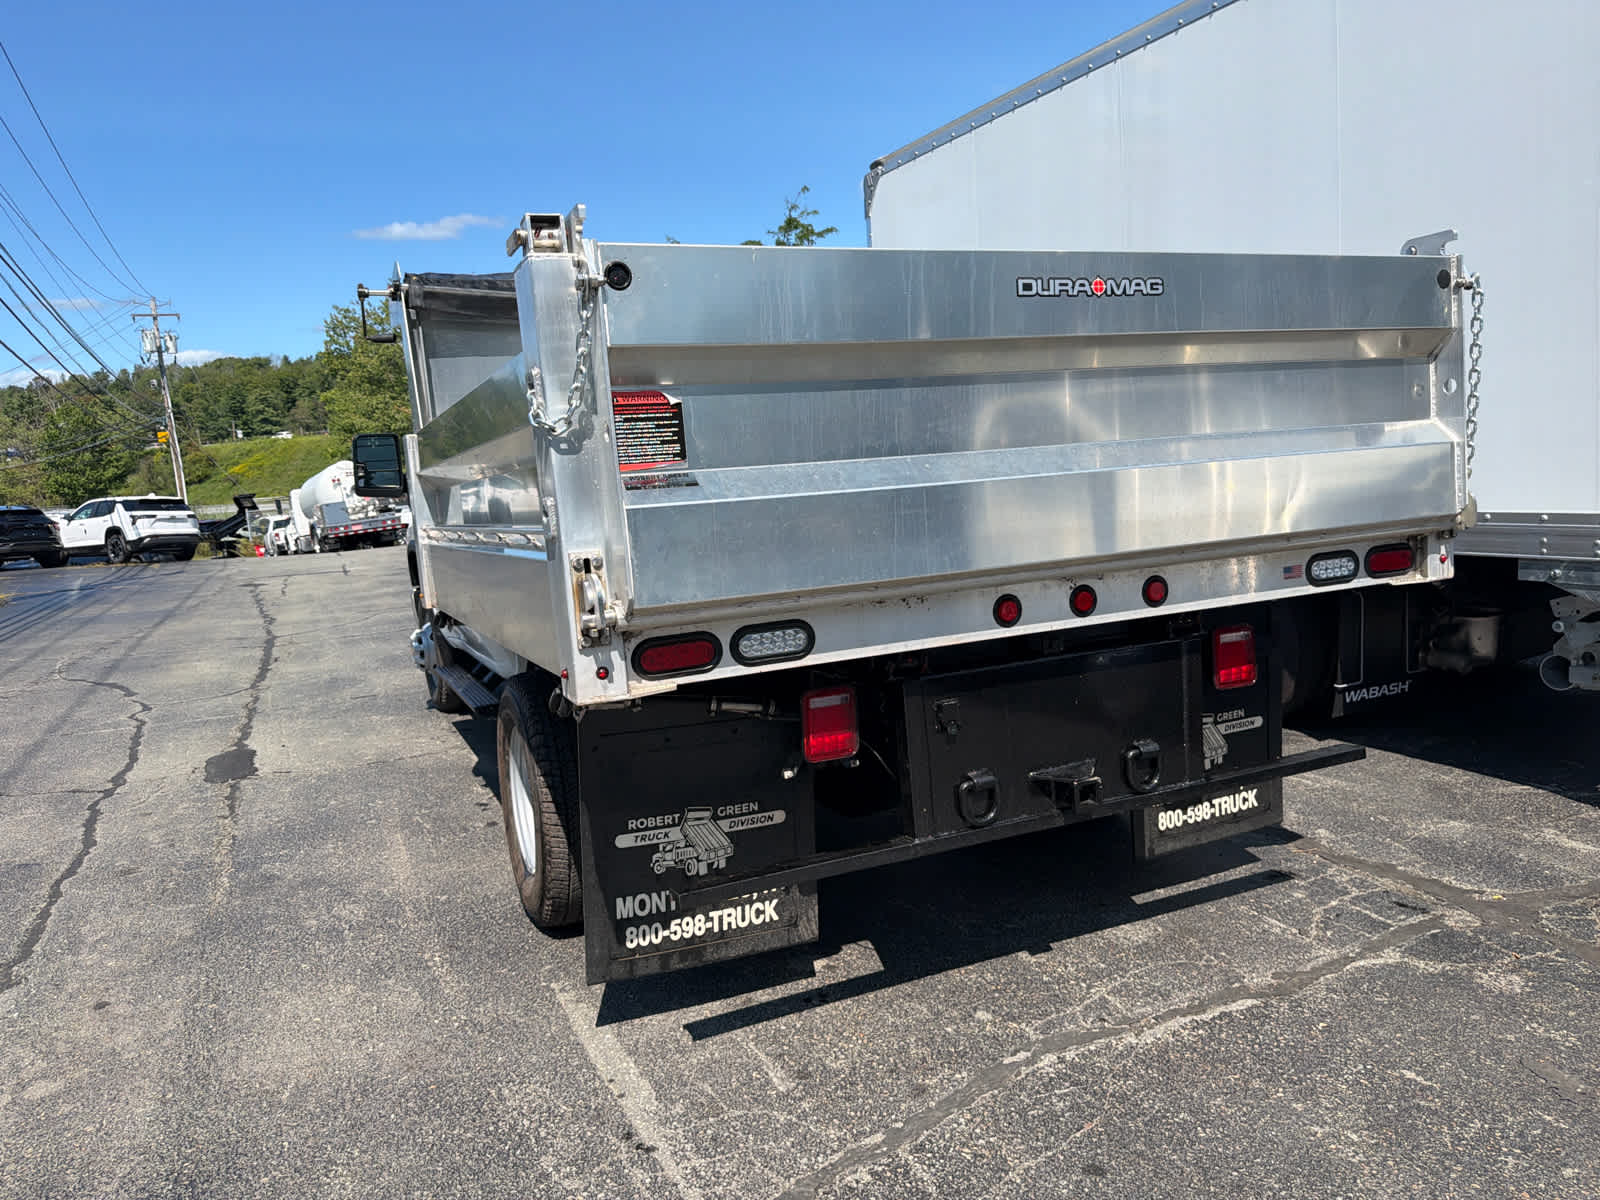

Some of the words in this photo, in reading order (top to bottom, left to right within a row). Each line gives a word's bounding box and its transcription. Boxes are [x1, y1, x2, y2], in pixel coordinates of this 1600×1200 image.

[1345, 681, 1409, 703] WABASH
[1217, 708, 1245, 722] GREEN
[1224, 719, 1256, 732] DIVISION
[627, 813, 681, 830] ROBERT
[717, 801, 759, 817] GREEN
[1158, 788, 1259, 831] 800-598-TRUCK
[633, 830, 671, 843] TRUCK
[728, 813, 775, 830] DIVISION
[625, 899, 780, 949] 800-598-TRUCK
